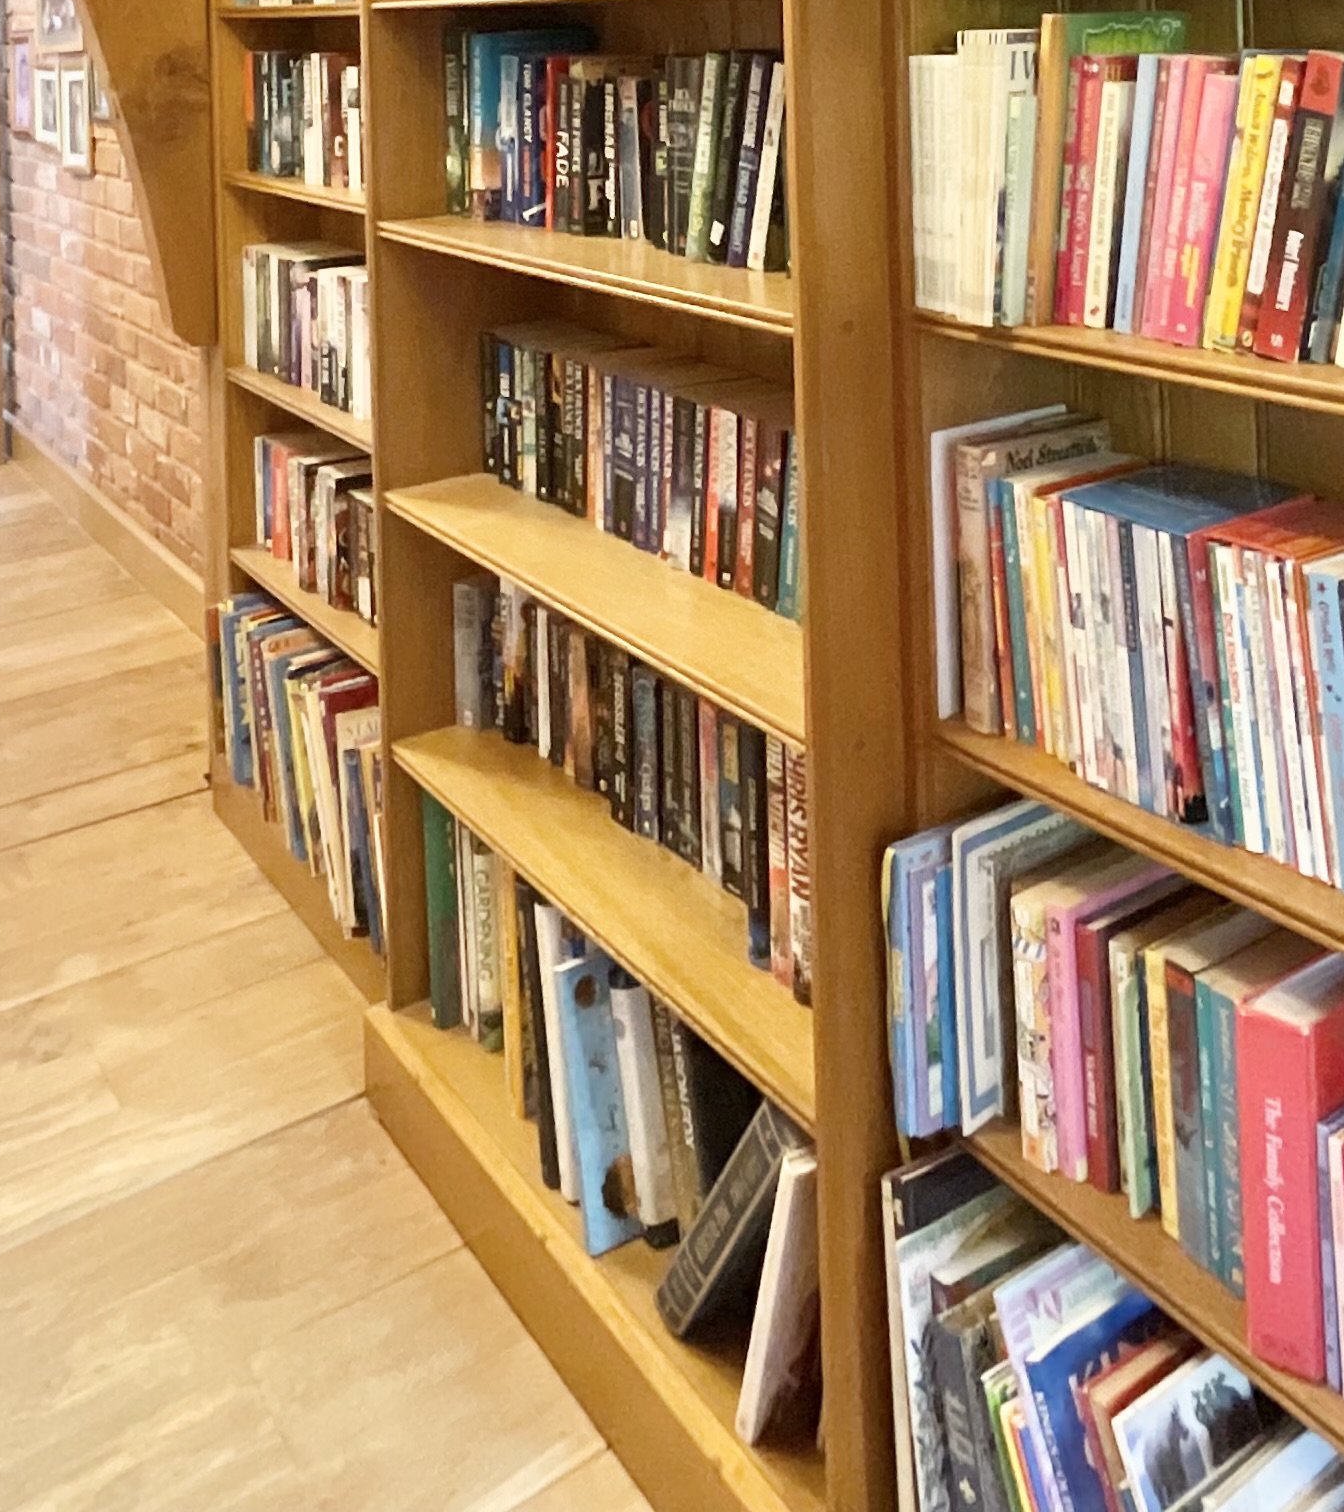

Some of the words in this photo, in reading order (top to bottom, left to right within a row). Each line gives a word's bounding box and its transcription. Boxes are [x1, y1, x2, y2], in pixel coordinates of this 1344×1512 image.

[556, 130, 569, 188] FADE
[635, 419, 646, 468] FRANCIS
[651, 423, 660, 473] FRANCIS
[744, 419, 755, 452] DICK
[742, 454, 755, 508] FRANCIS
[791, 821, 811, 902] RYAN
[475, 870, 494, 981] GARDENING
[1264, 1096, 1282, 1130] The
[1264, 1132, 1285, 1190] Family
[1265, 1195, 1286, 1284] Collection
